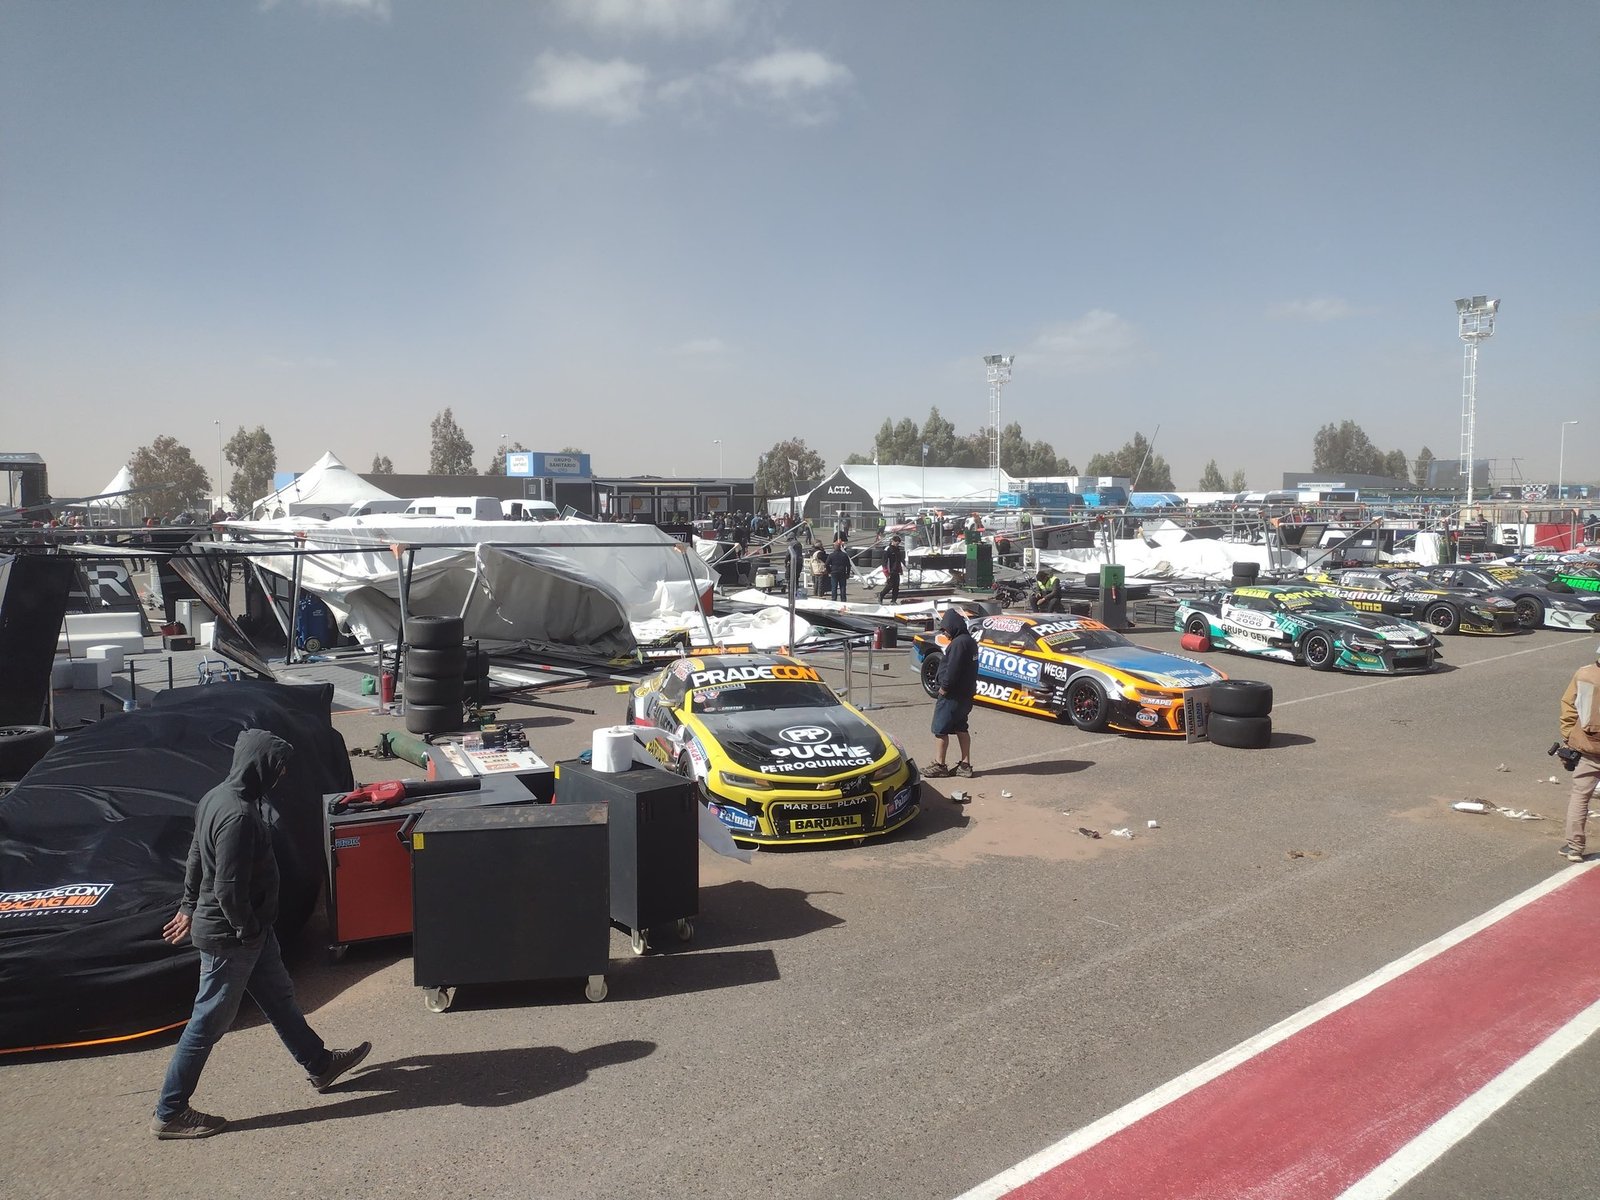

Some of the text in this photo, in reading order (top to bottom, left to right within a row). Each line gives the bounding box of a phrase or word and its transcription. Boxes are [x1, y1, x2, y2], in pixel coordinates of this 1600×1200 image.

[1404, 592, 1438, 601] EXPERTA
[1237, 618, 1262, 627] 2000
[1221, 623, 1248, 637] GRUPO
[691, 665, 820, 687] PRADECON
[1044, 662, 1067, 679] WEGA
[1146, 698, 1172, 706] MAPEI
[760, 757, 874, 774] PETROQUIMICOS
[837, 797, 867, 808] PLATA
[719, 808, 756, 828] Palmar
[795, 815, 858, 830] BARDAHL
[0, 897, 65, 910] RACING
